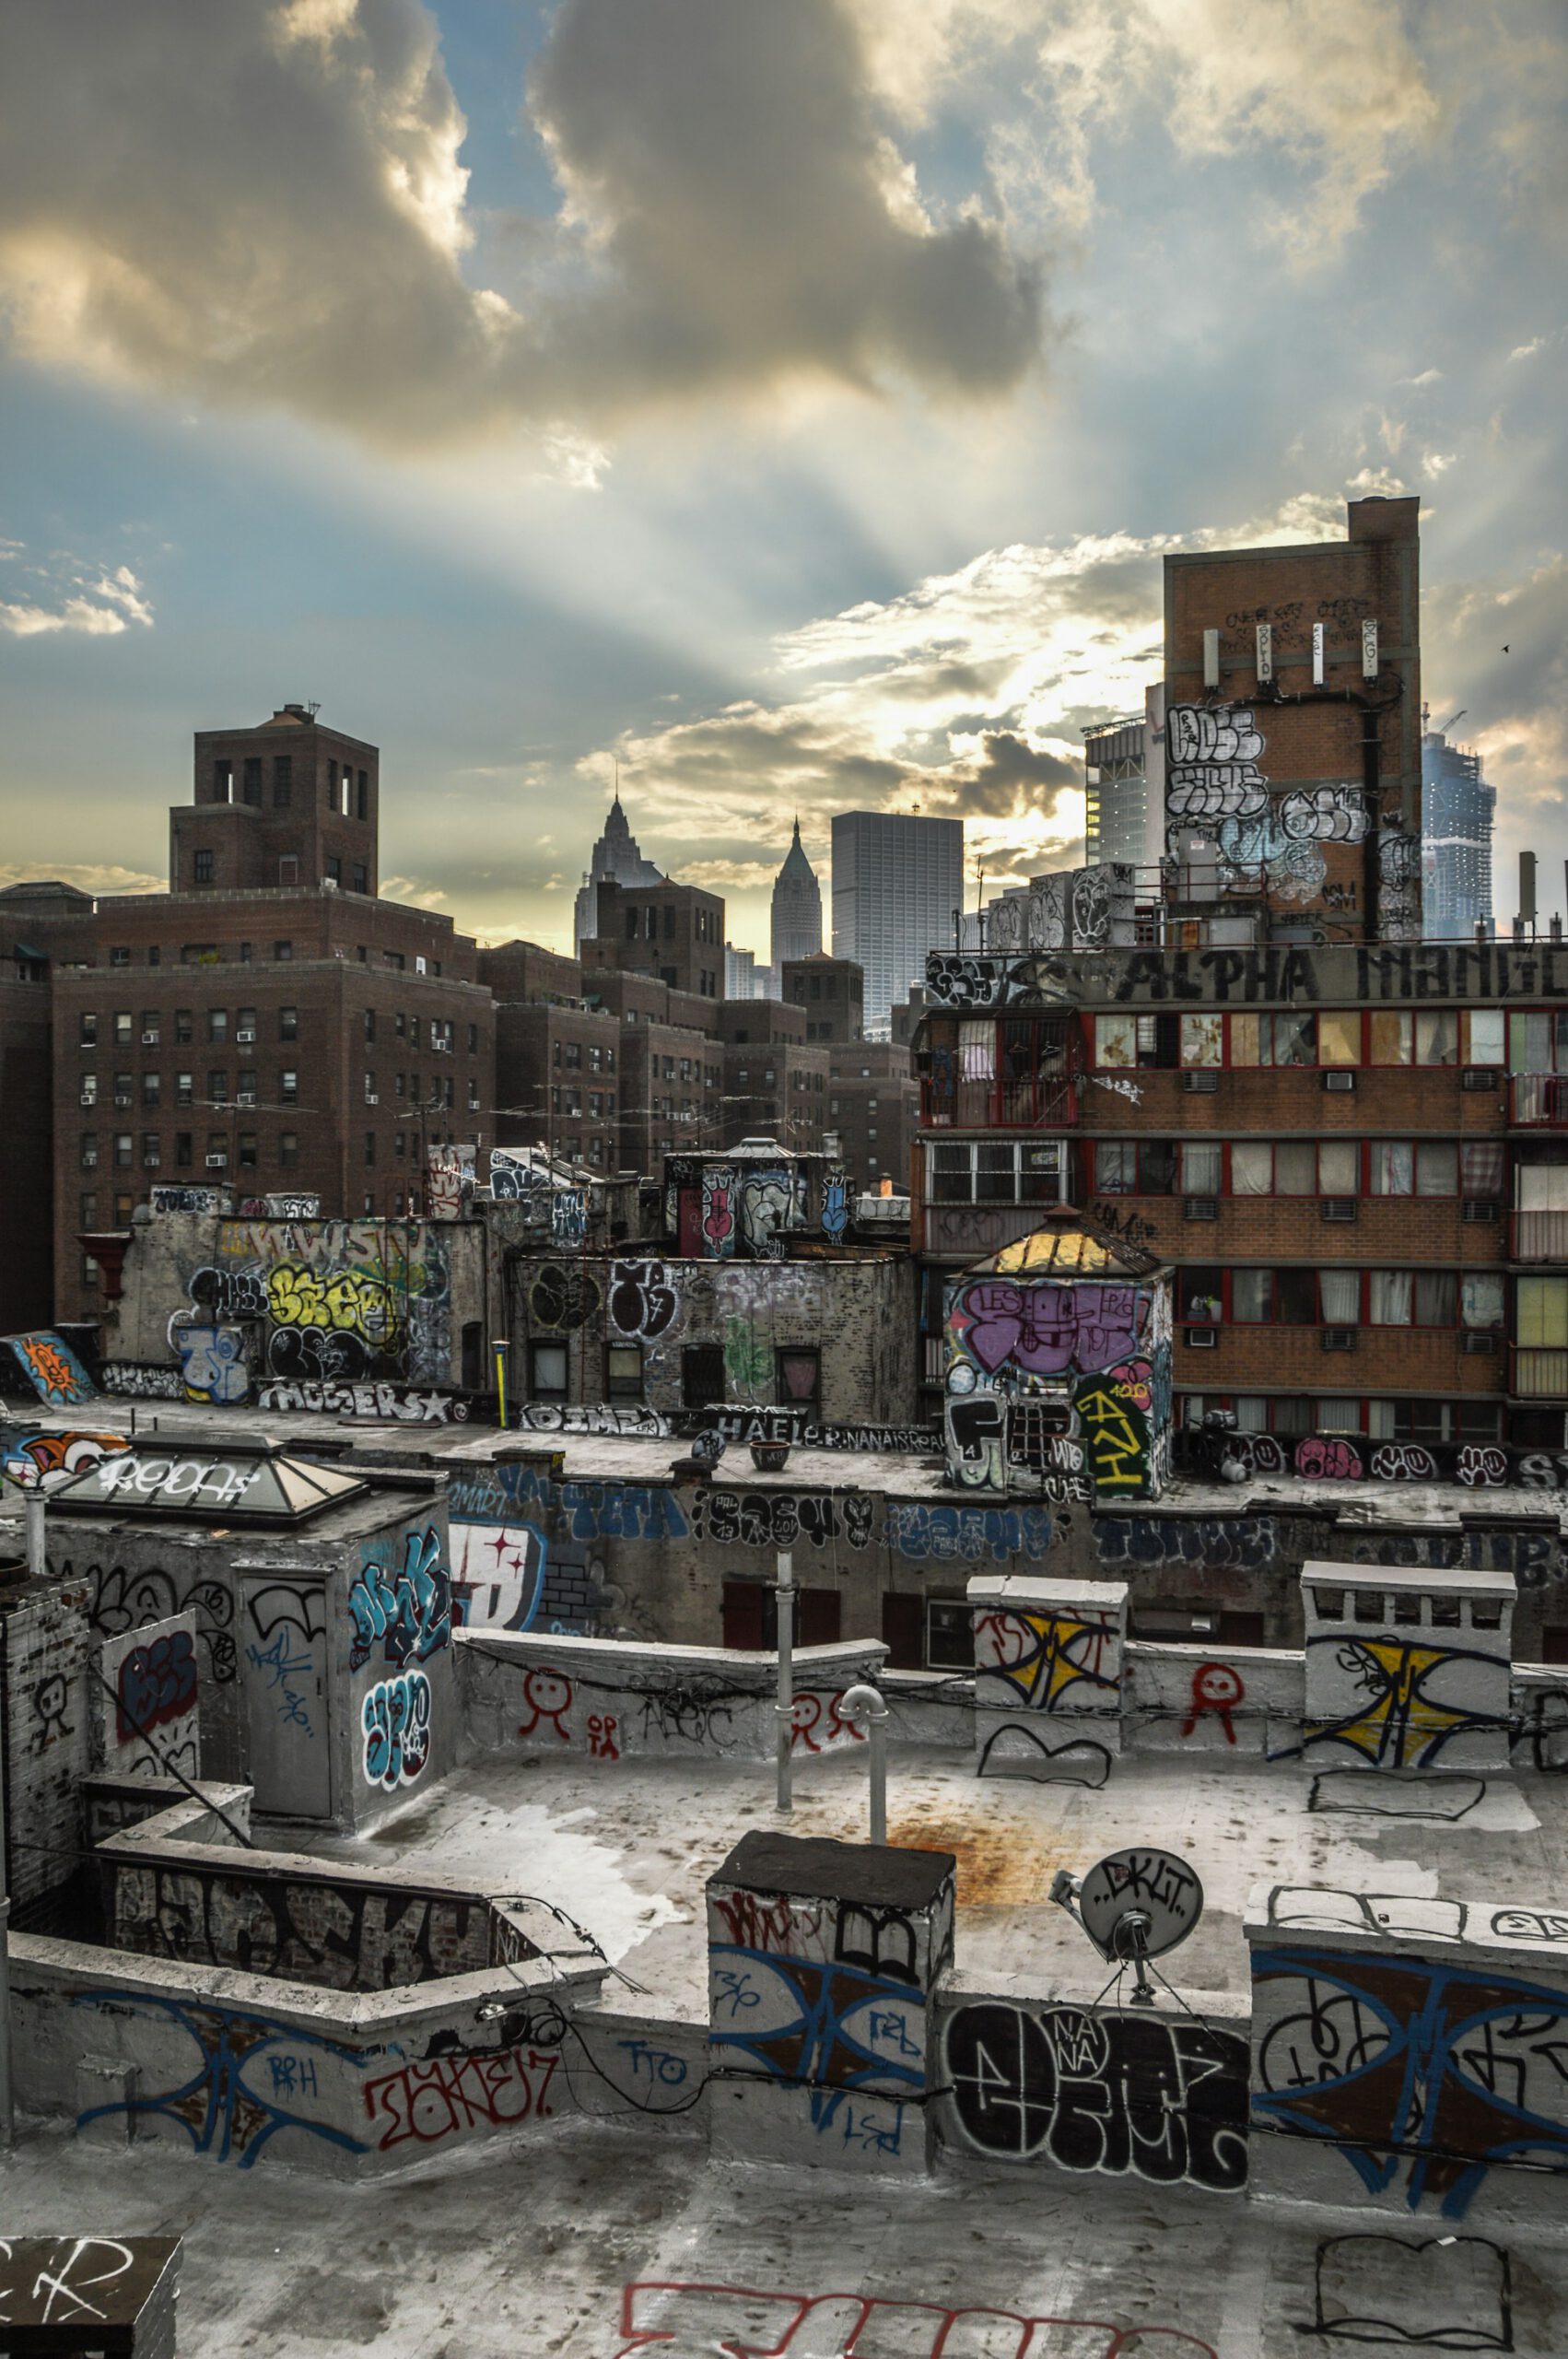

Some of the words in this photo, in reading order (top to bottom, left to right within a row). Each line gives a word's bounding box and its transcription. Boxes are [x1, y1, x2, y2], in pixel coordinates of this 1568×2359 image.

[1116, 950, 1319, 1001] ALPHA
[1053, 2013, 1100, 2047] NA
[1057, 2038, 1099, 2072] NA
